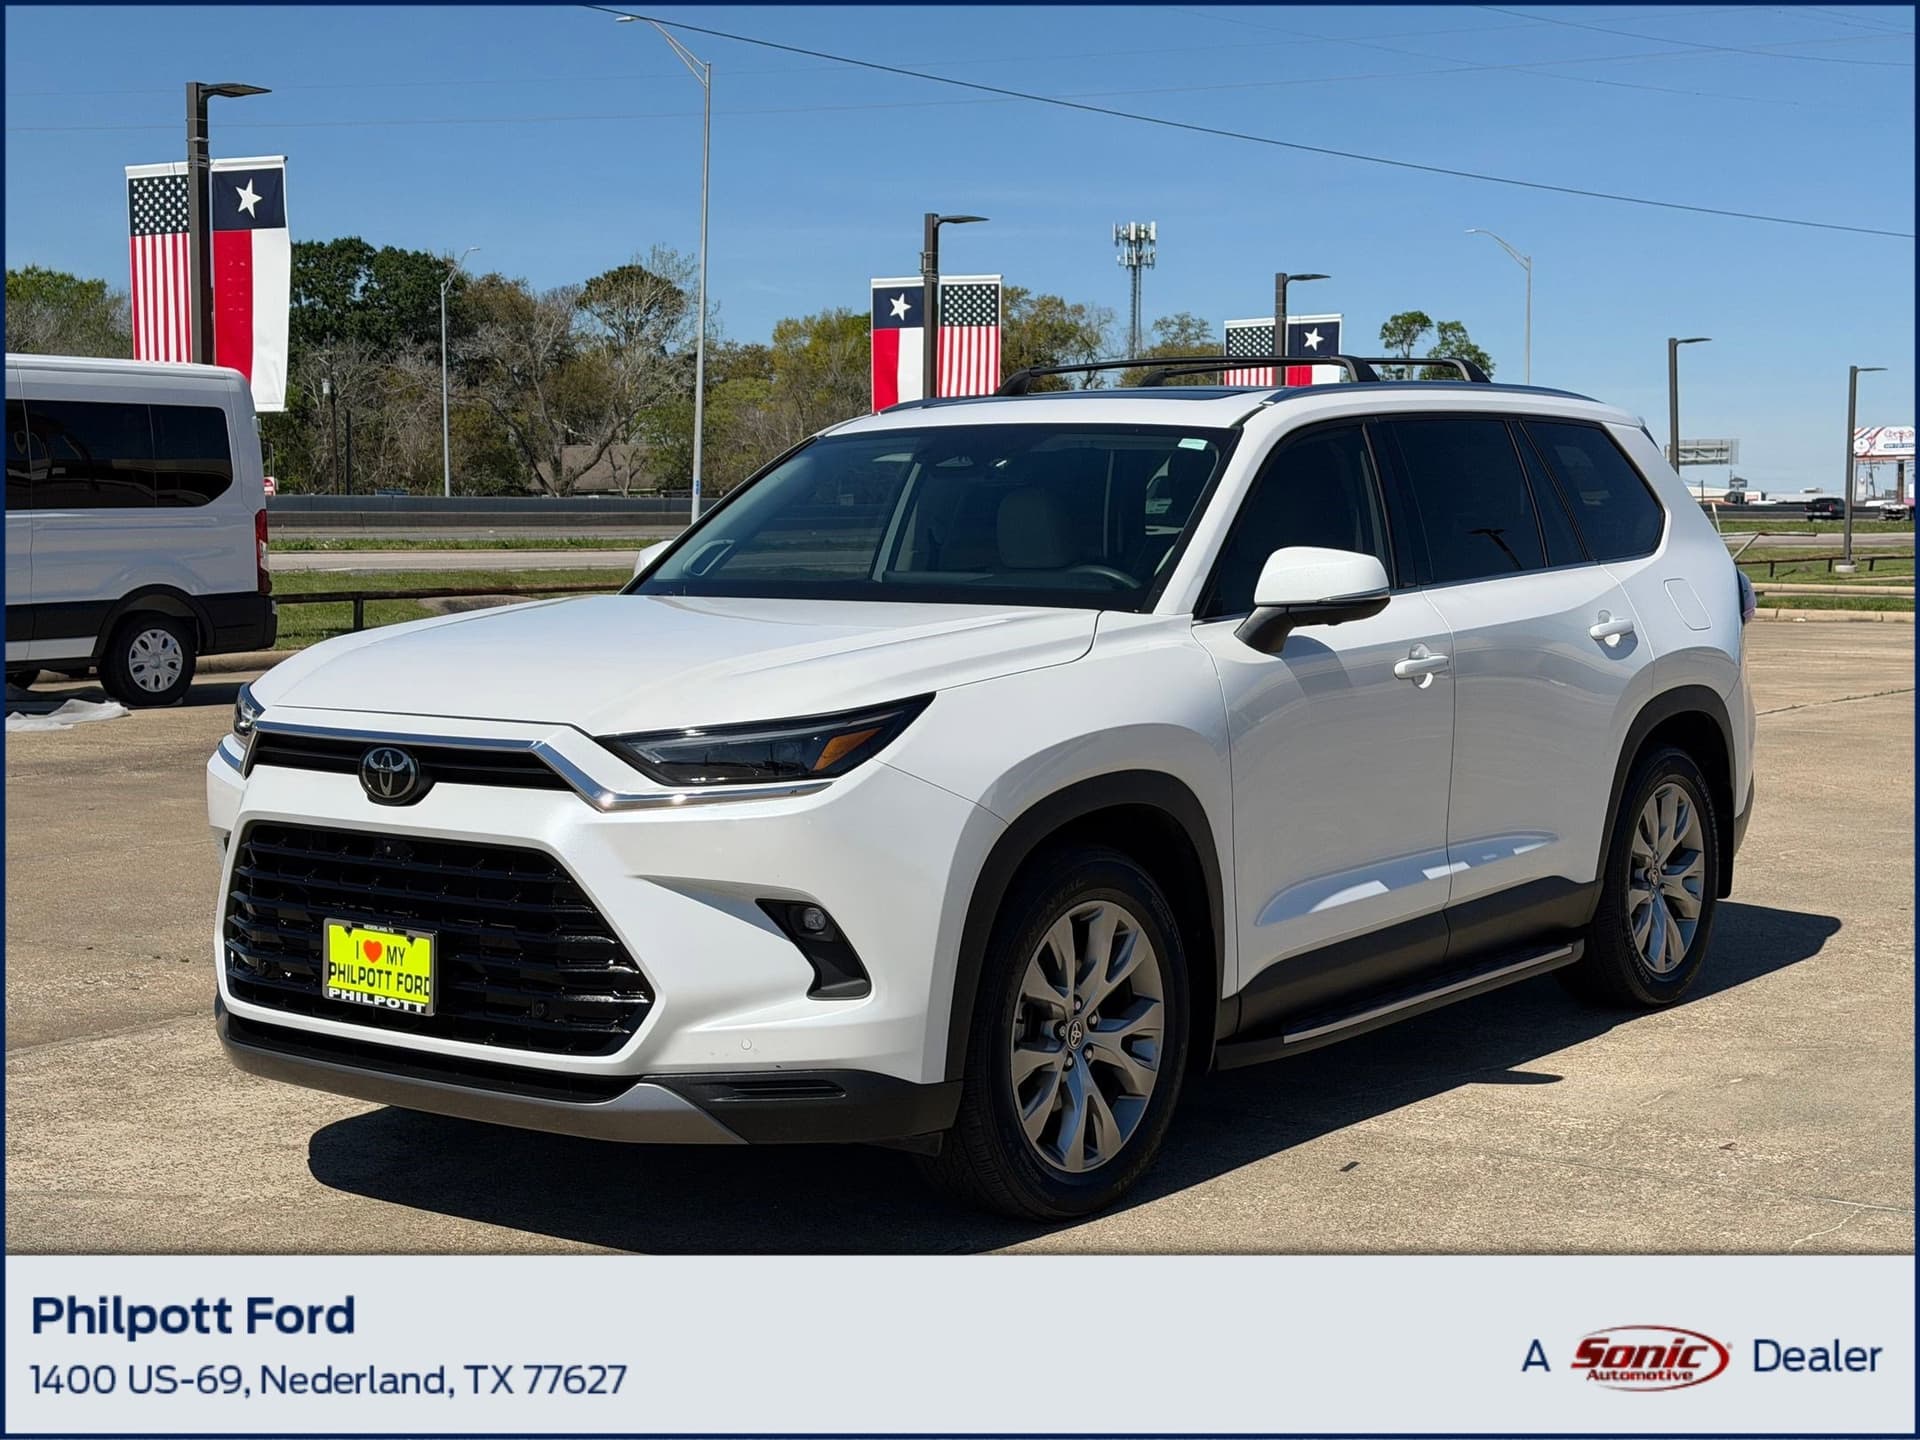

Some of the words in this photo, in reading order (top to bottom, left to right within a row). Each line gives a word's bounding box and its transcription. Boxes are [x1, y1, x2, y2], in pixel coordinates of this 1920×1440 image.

[355, 940, 360, 960] I
[386, 945, 406, 967] MY
[329, 961, 392, 990] PHILPOTT
[397, 972, 430, 996] FORD
[328, 988, 426, 1013] PHILPOTT
